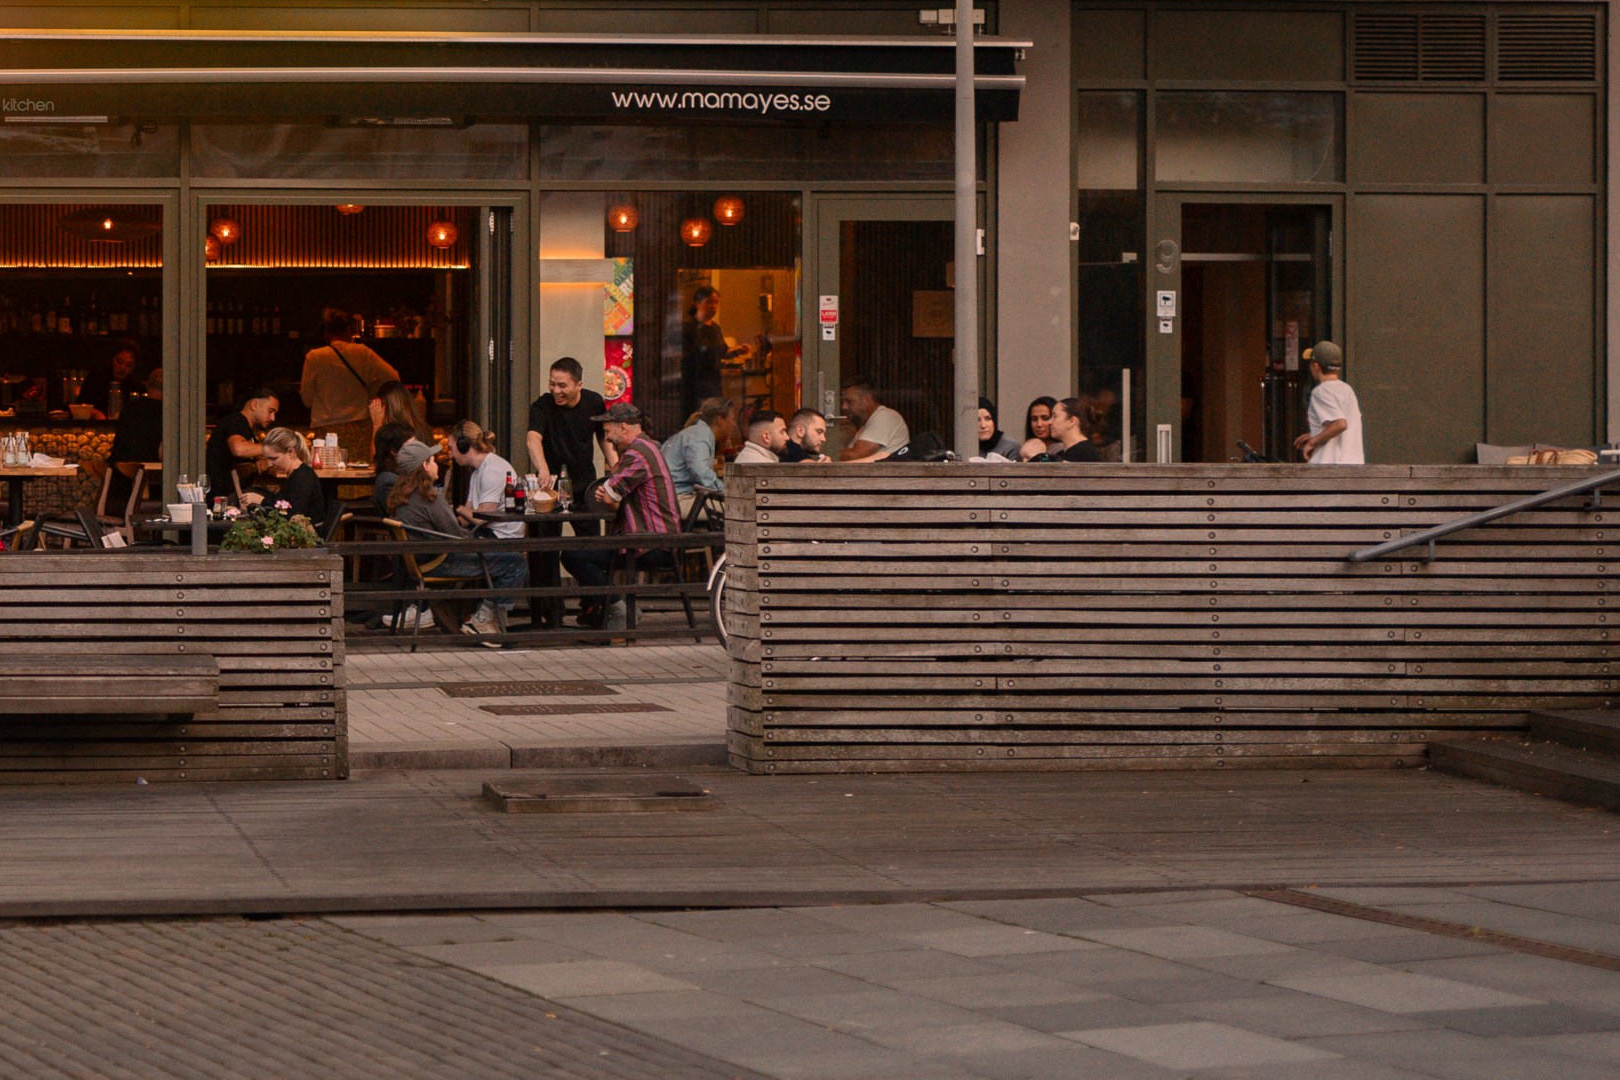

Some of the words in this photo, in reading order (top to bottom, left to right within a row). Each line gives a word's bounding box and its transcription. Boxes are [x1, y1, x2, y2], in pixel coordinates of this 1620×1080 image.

[2, 98, 55, 112] kitchen
[611, 91, 831, 114] www.mamayes.se
[1156, 239, 1180, 274] 9
